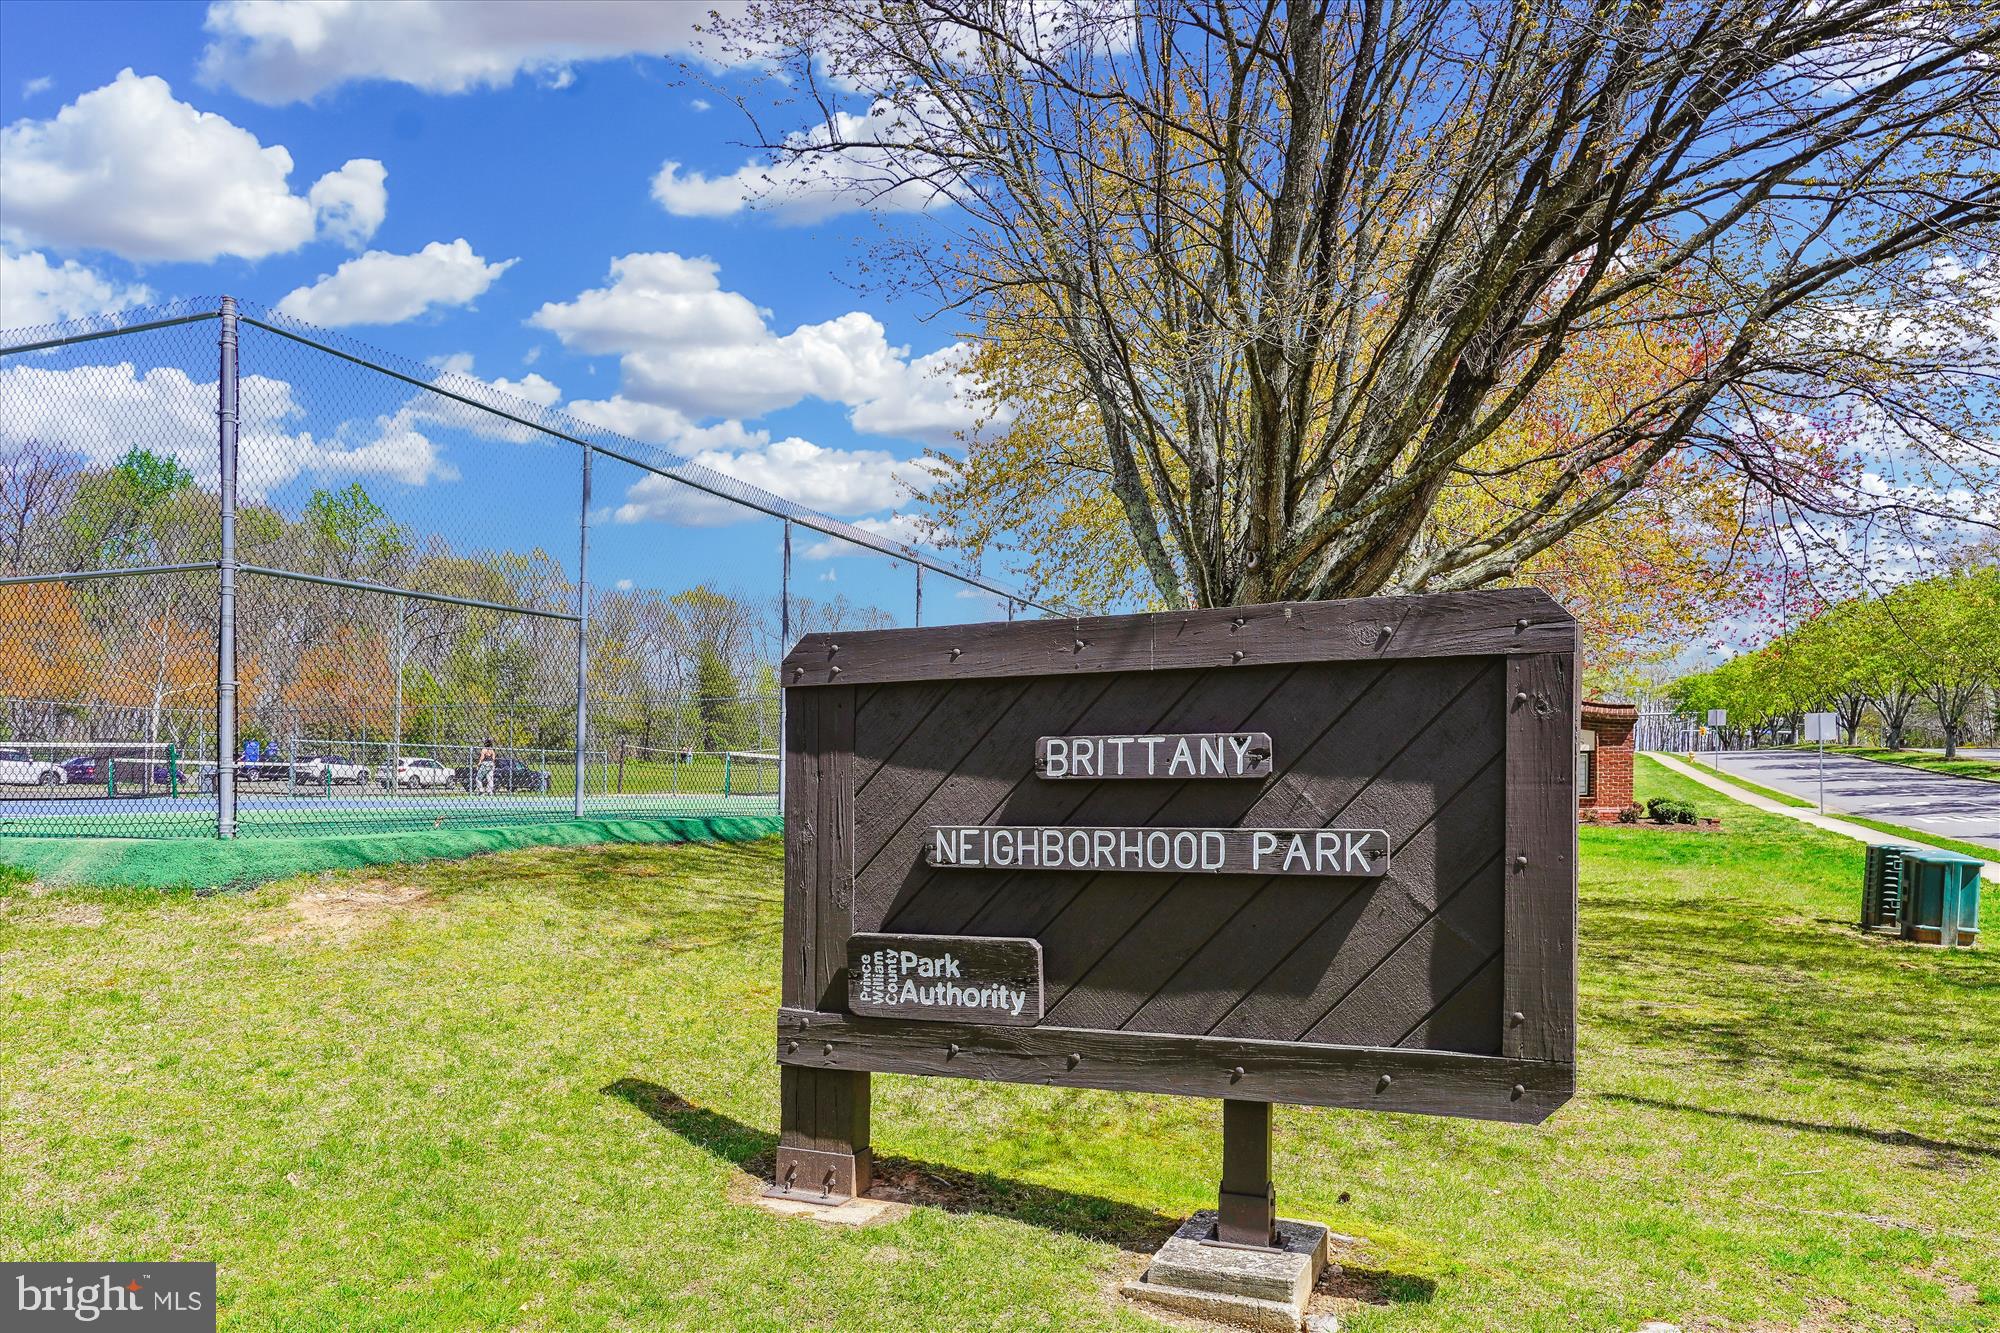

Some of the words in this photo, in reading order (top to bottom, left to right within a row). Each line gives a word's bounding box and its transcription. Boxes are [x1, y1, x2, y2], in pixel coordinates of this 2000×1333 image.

[1046, 736, 1251, 776] BRITTANY
[936, 829, 1225, 869] NEIGHBORHOOD
[1252, 832, 1371, 872] PARK
[859, 954, 872, 1001] Prince
[872, 951, 884, 1004] William
[885, 949, 899, 1005] County
[900, 951, 961, 978] Park
[900, 979, 1026, 1016] Authority
